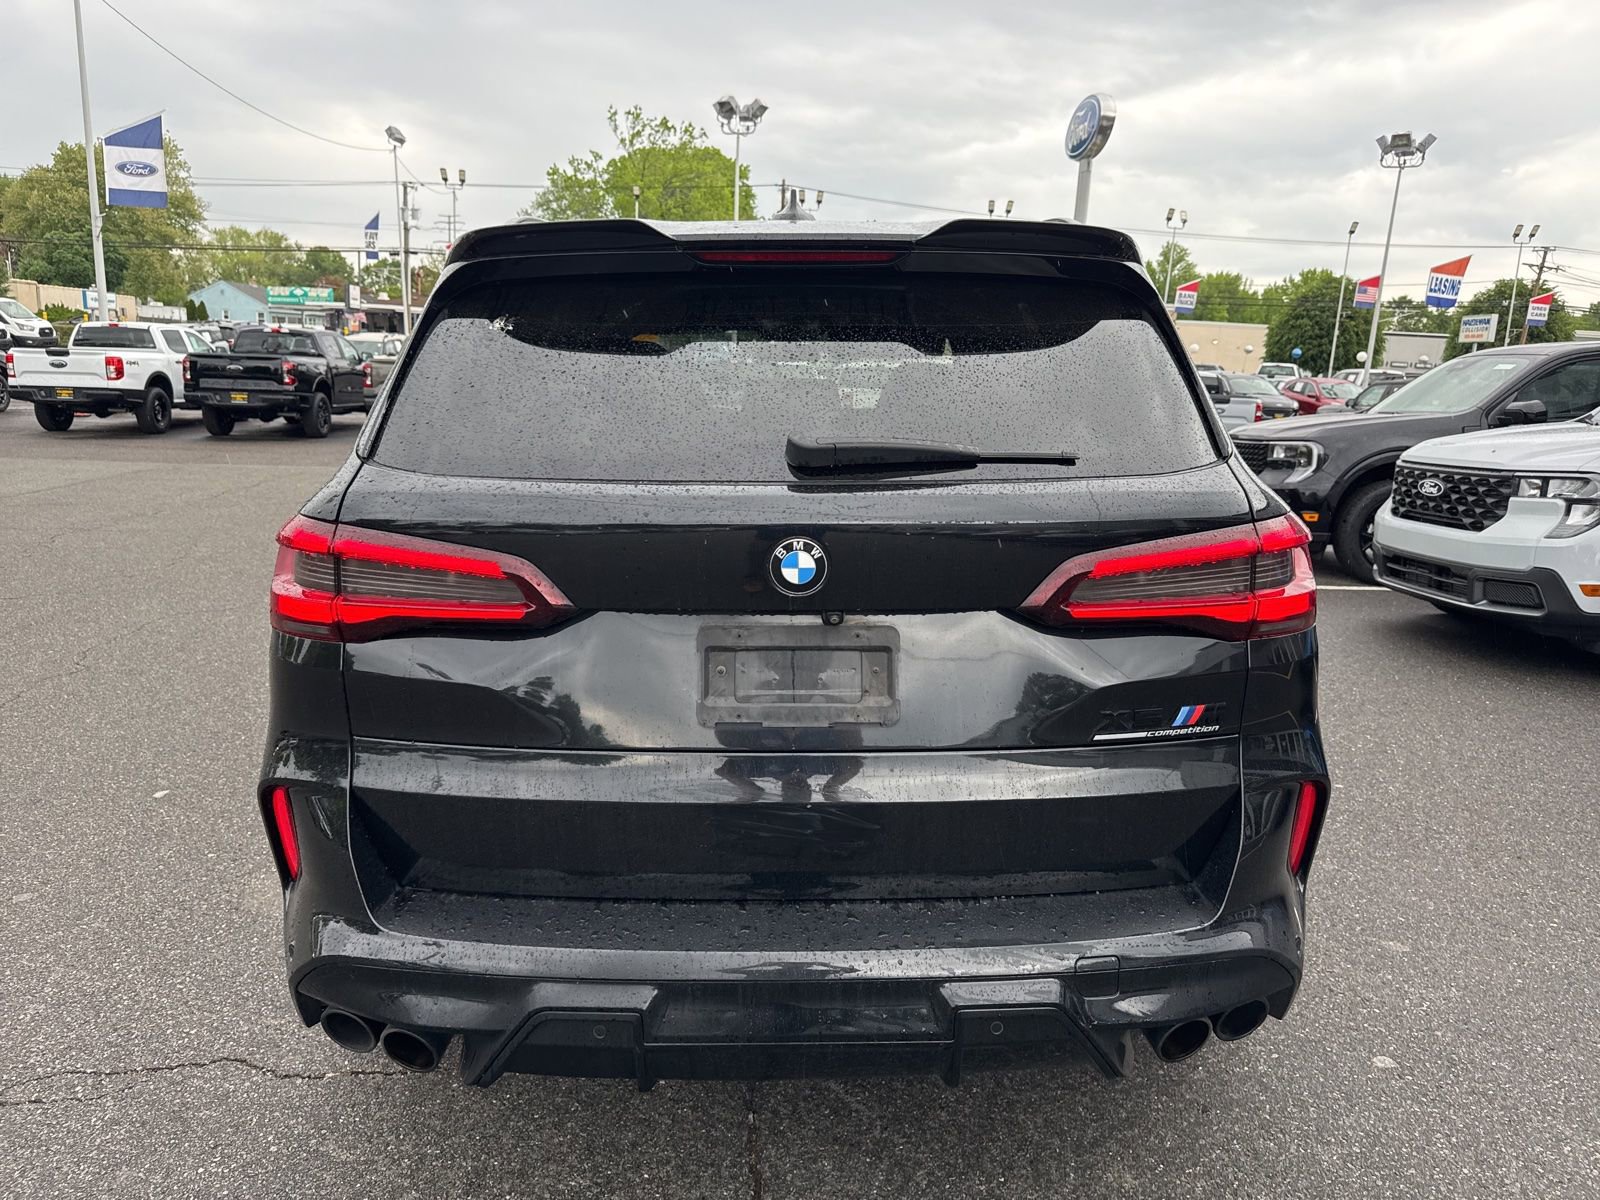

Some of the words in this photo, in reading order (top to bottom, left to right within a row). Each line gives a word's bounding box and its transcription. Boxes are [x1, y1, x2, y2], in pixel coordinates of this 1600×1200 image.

[1069, 107, 1091, 149] Ford
[124, 163, 150, 175] Ford
[1429, 276, 1461, 297] LEASING
[1421, 481, 1439, 494] Ford
[775, 541, 822, 559] BMW
[1147, 725, 1220, 737] competition
